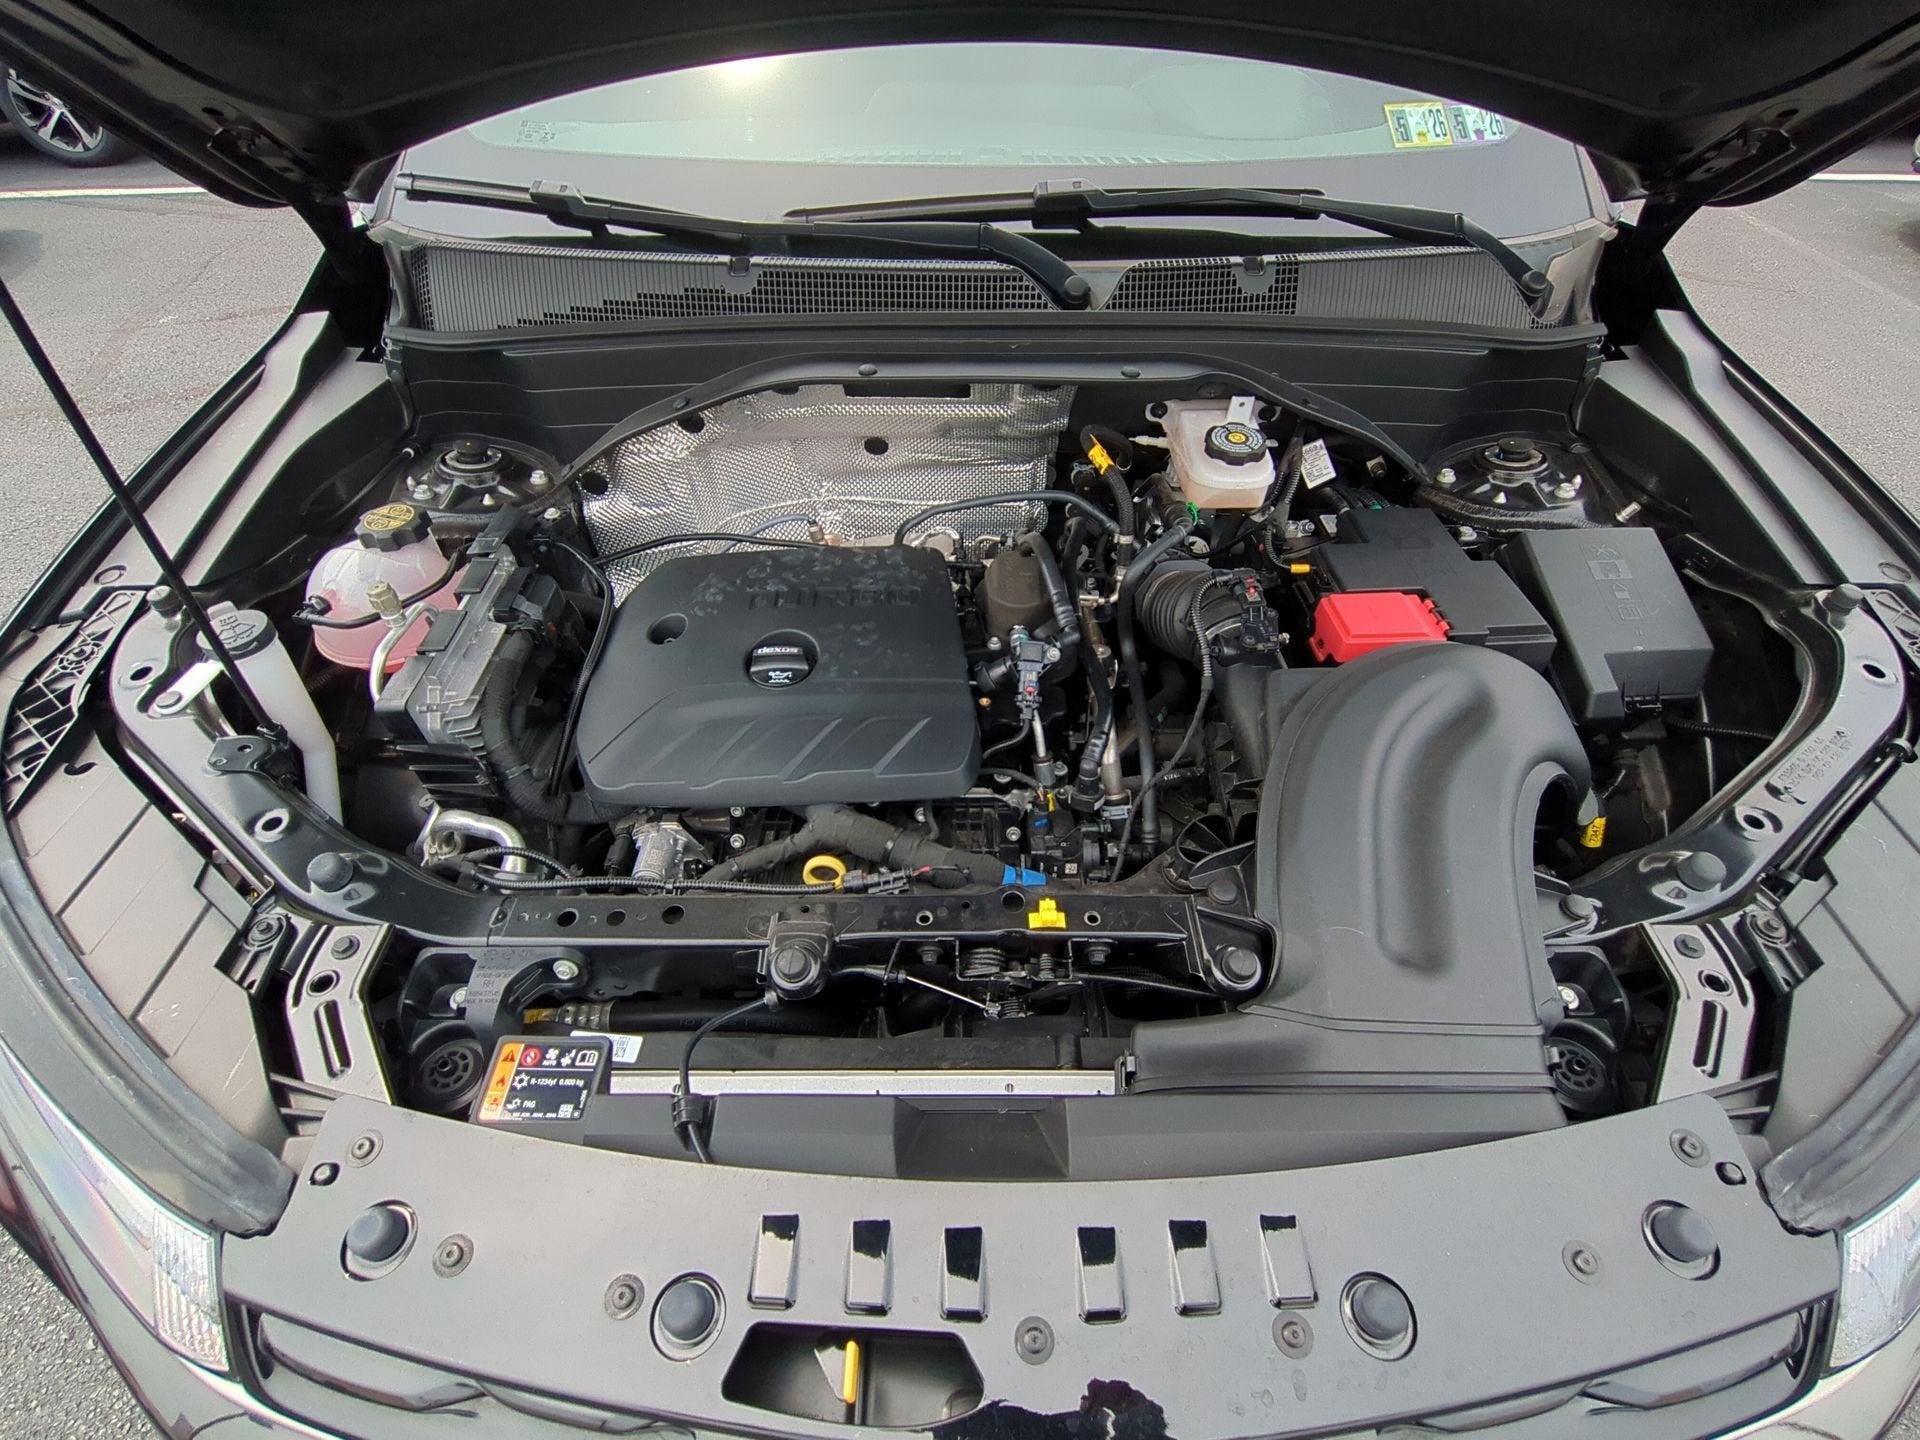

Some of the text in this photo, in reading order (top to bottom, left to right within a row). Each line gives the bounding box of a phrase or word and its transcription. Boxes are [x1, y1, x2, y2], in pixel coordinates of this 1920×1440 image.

[1395, 108, 1448, 142] 5 26
[1453, 110, 1504, 139] 5 26
[757, 646, 799, 654] dexos
[530, 1077, 557, 1087] R-1234yf
[576, 1078, 584, 1087] kg
[522, 1099, 536, 1109] PAG
